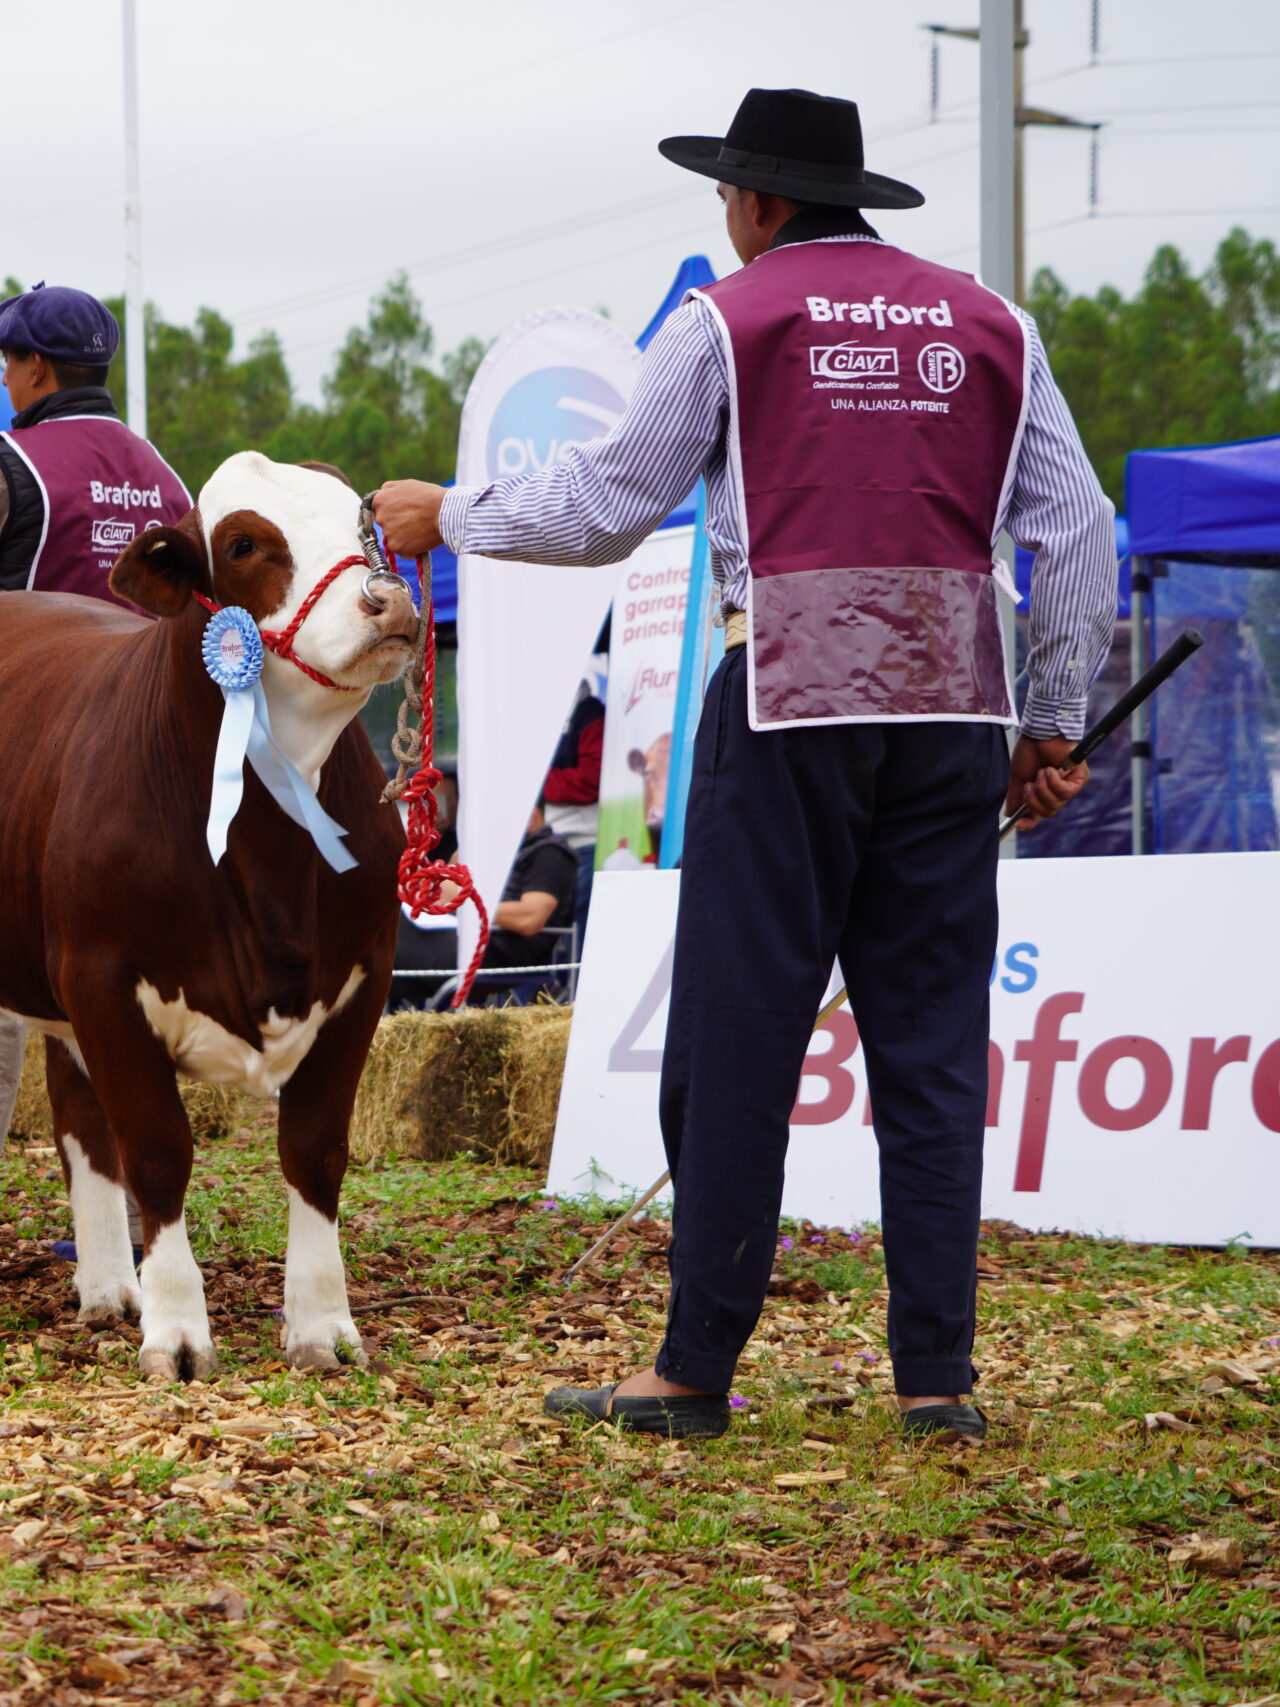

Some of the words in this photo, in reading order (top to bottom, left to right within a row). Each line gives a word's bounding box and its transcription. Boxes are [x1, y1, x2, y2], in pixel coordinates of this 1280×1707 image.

[806, 296, 953, 330] Braford
[926, 350, 937, 382] SEMEX
[866, 381, 899, 390] Confiable
[831, 399, 855, 410] UNA
[858, 400, 908, 411] ALIANZA
[910, 401, 950, 414] POTENTE
[90, 480, 162, 511] Braford
